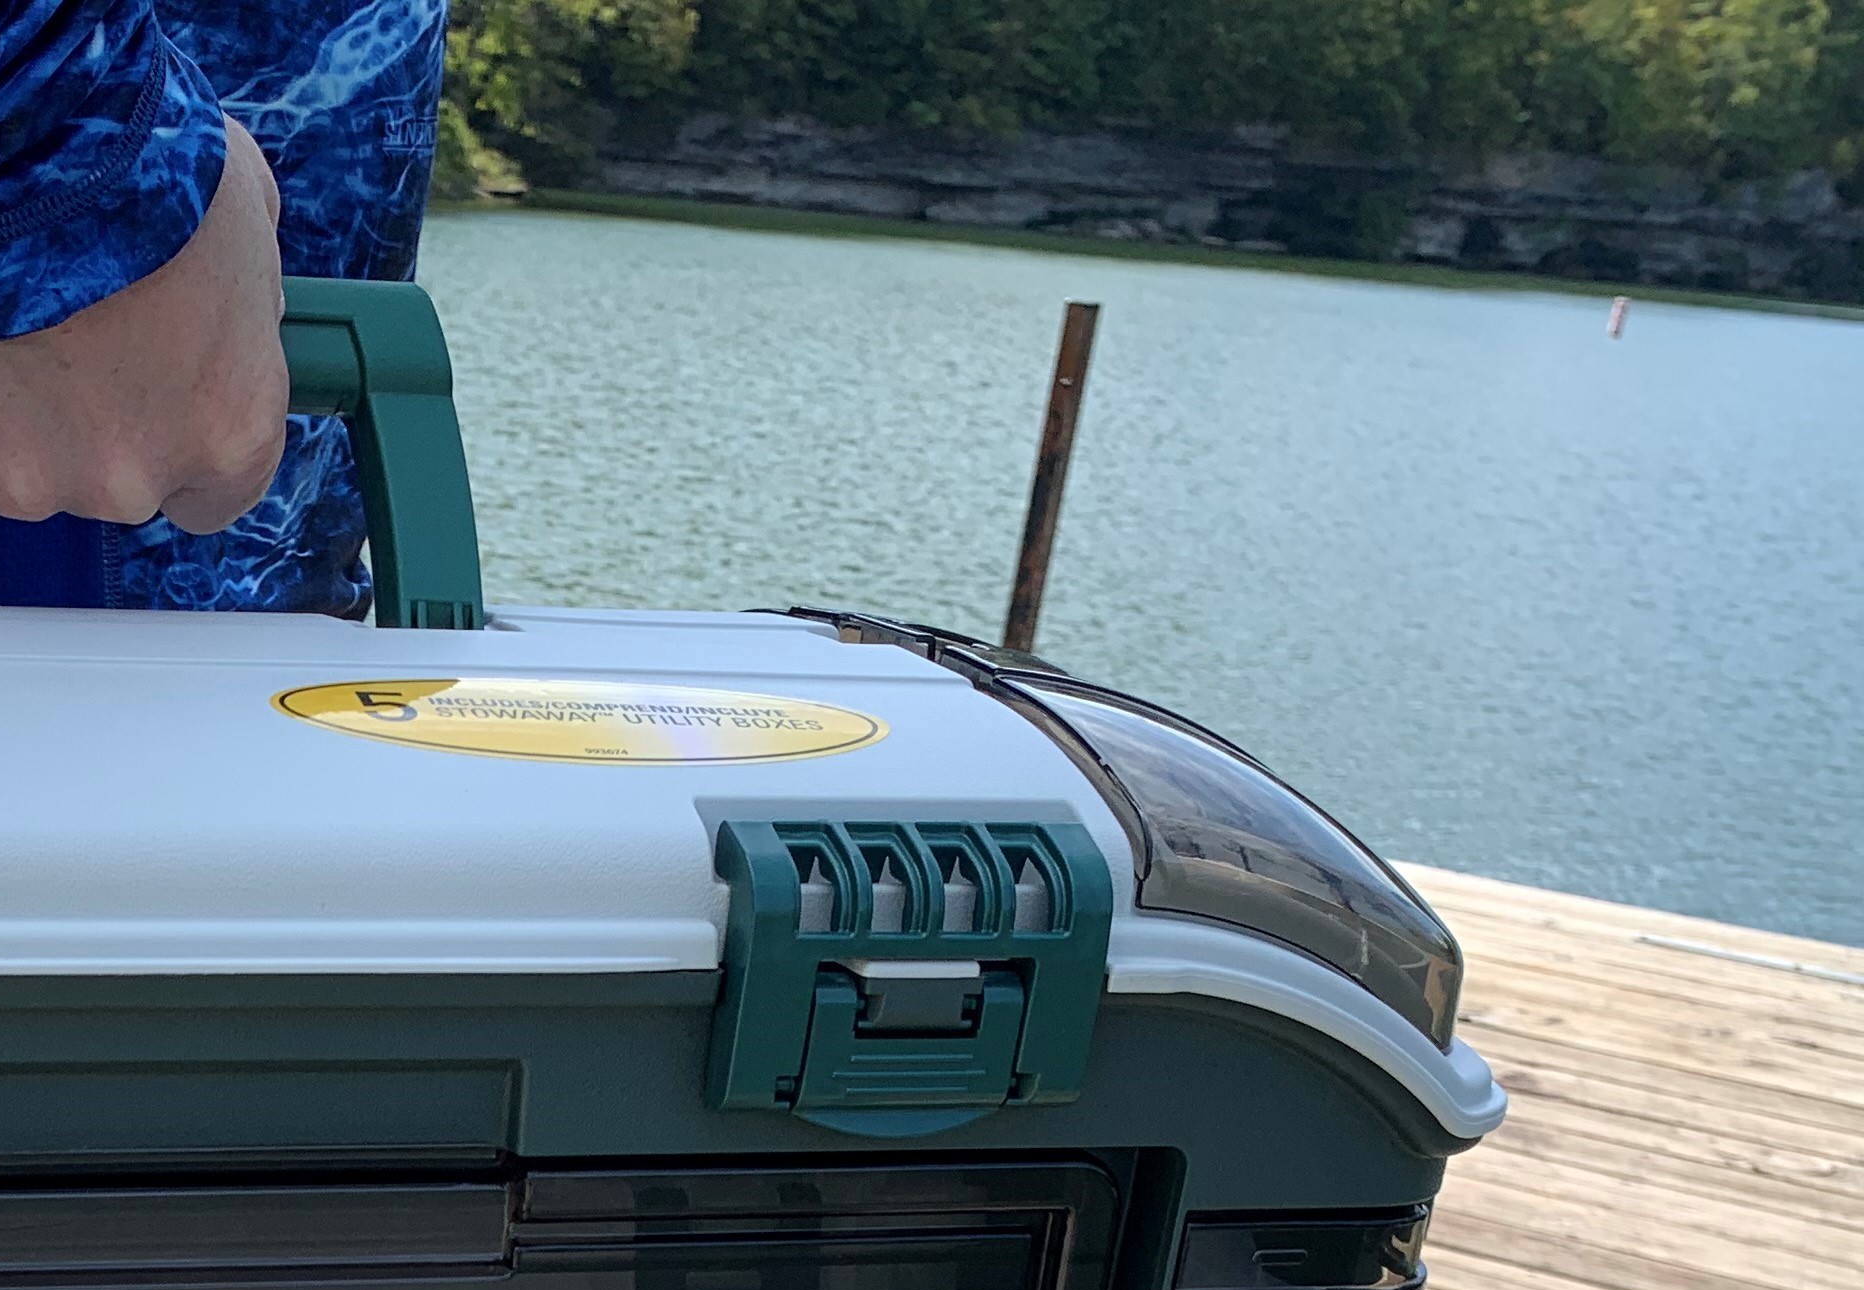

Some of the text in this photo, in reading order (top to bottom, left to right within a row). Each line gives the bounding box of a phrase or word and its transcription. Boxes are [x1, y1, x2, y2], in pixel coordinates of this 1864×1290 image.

[354, 691, 419, 722] 5
[427, 696, 791, 718] INCLUDES/COMPREND/INCLUYE
[622, 713, 727, 727] UTILITY
[732, 716, 824, 731] BOXES
